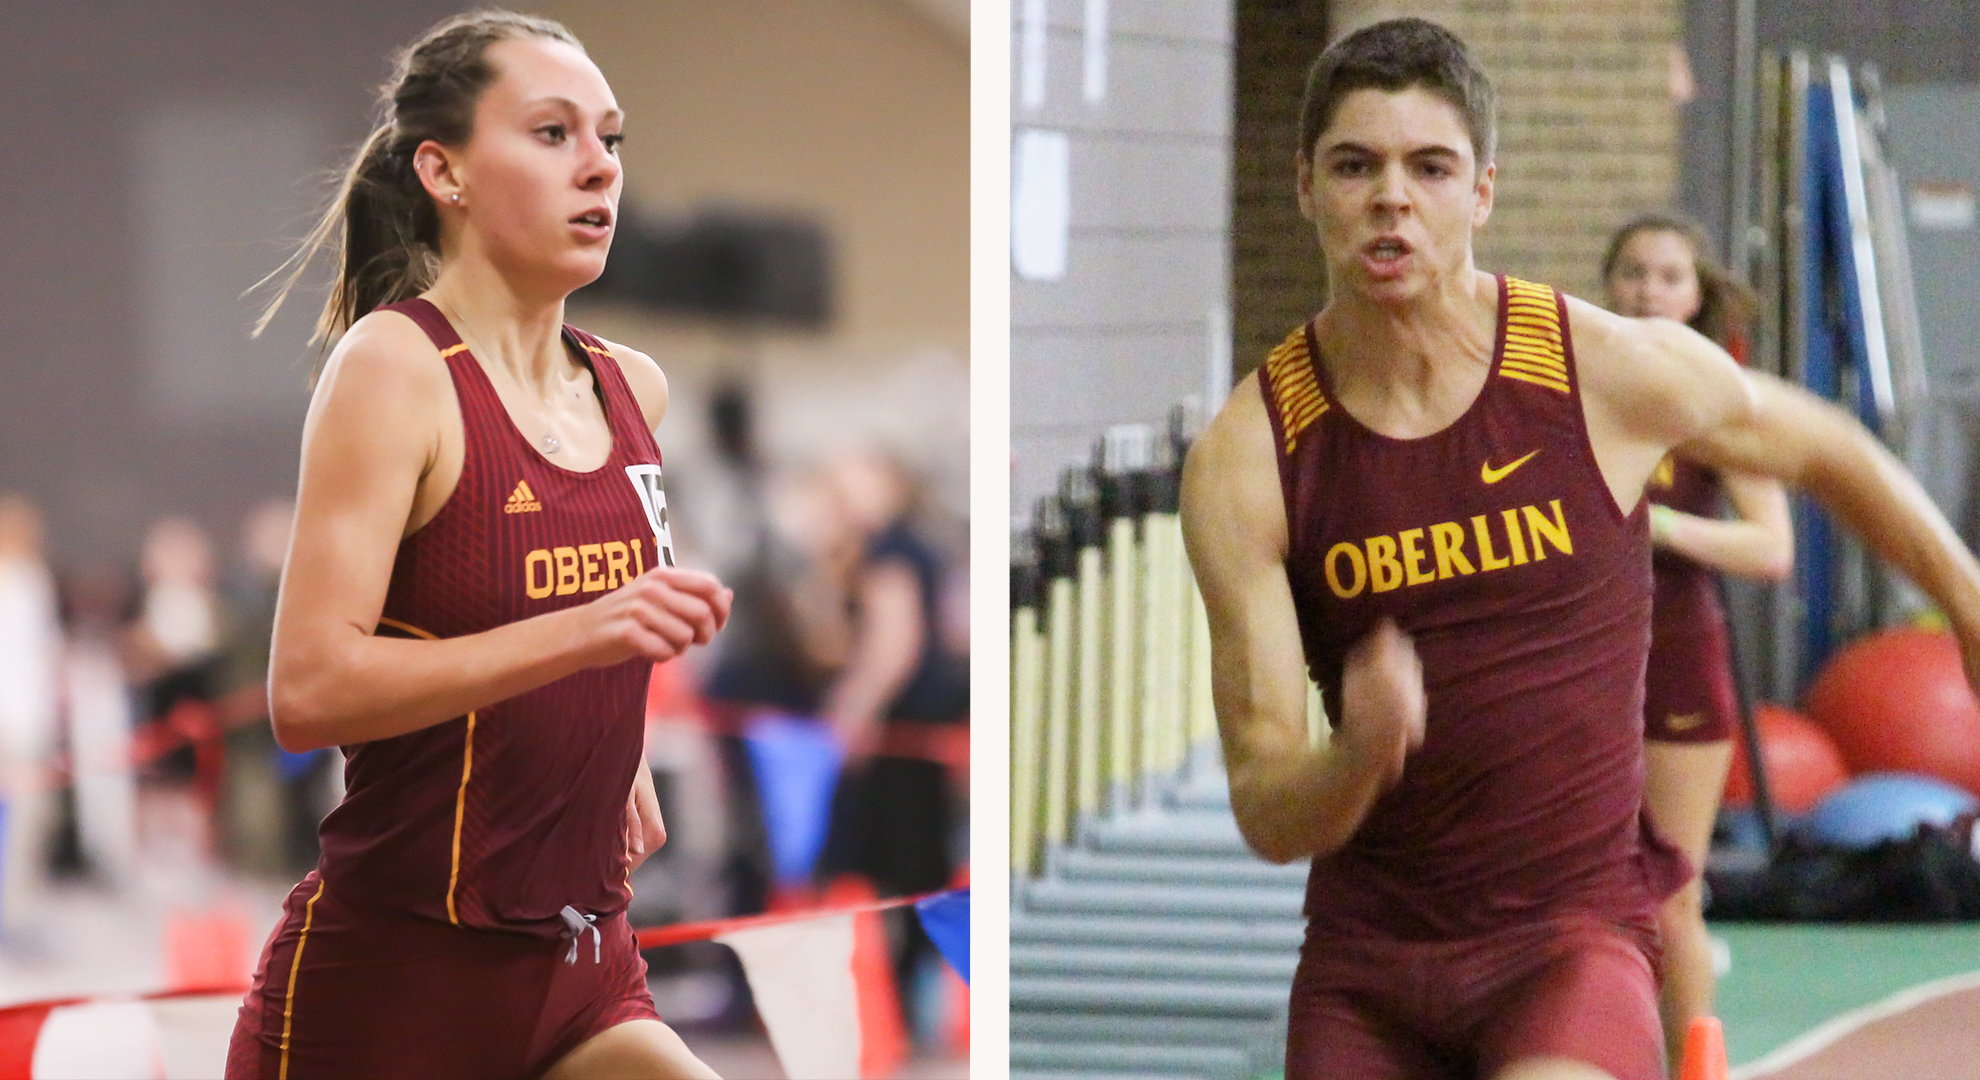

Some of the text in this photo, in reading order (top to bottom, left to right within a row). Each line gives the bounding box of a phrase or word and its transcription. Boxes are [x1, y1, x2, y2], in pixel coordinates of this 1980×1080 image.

[504, 501, 542, 514] adidas
[525, 538, 657, 600] OBERL
[1324, 499, 1573, 599] OBERLIN
